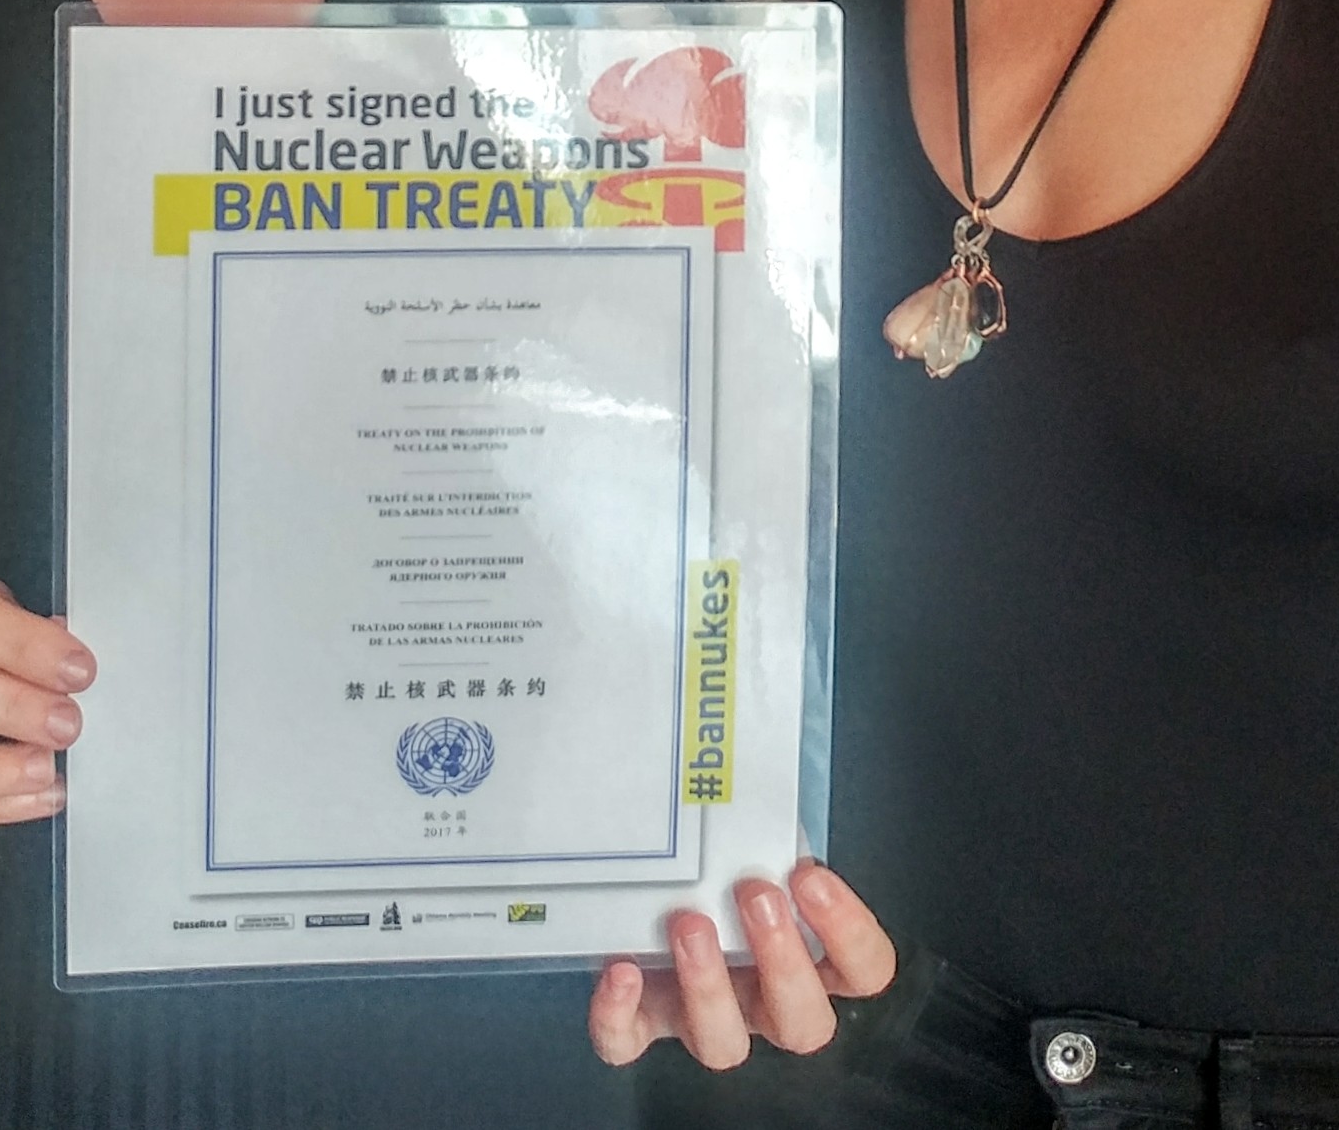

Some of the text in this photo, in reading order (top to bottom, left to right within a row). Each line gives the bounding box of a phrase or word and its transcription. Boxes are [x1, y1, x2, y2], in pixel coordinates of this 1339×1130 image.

[216, 84, 537, 127] I just signed the
[214, 128, 650, 180] Nuclear Weapons
[214, 179, 596, 233] BAN TREATY
[351, 623, 404, 633] TRATADO
[412, 636, 453, 645] ARMAS
[345, 677, 547, 701] 禁止核武器条约
[688, 568, 731, 800] #bannukes
[423, 826, 452, 838] 2017
[172, 919, 228, 930] Ceasefire.ca
